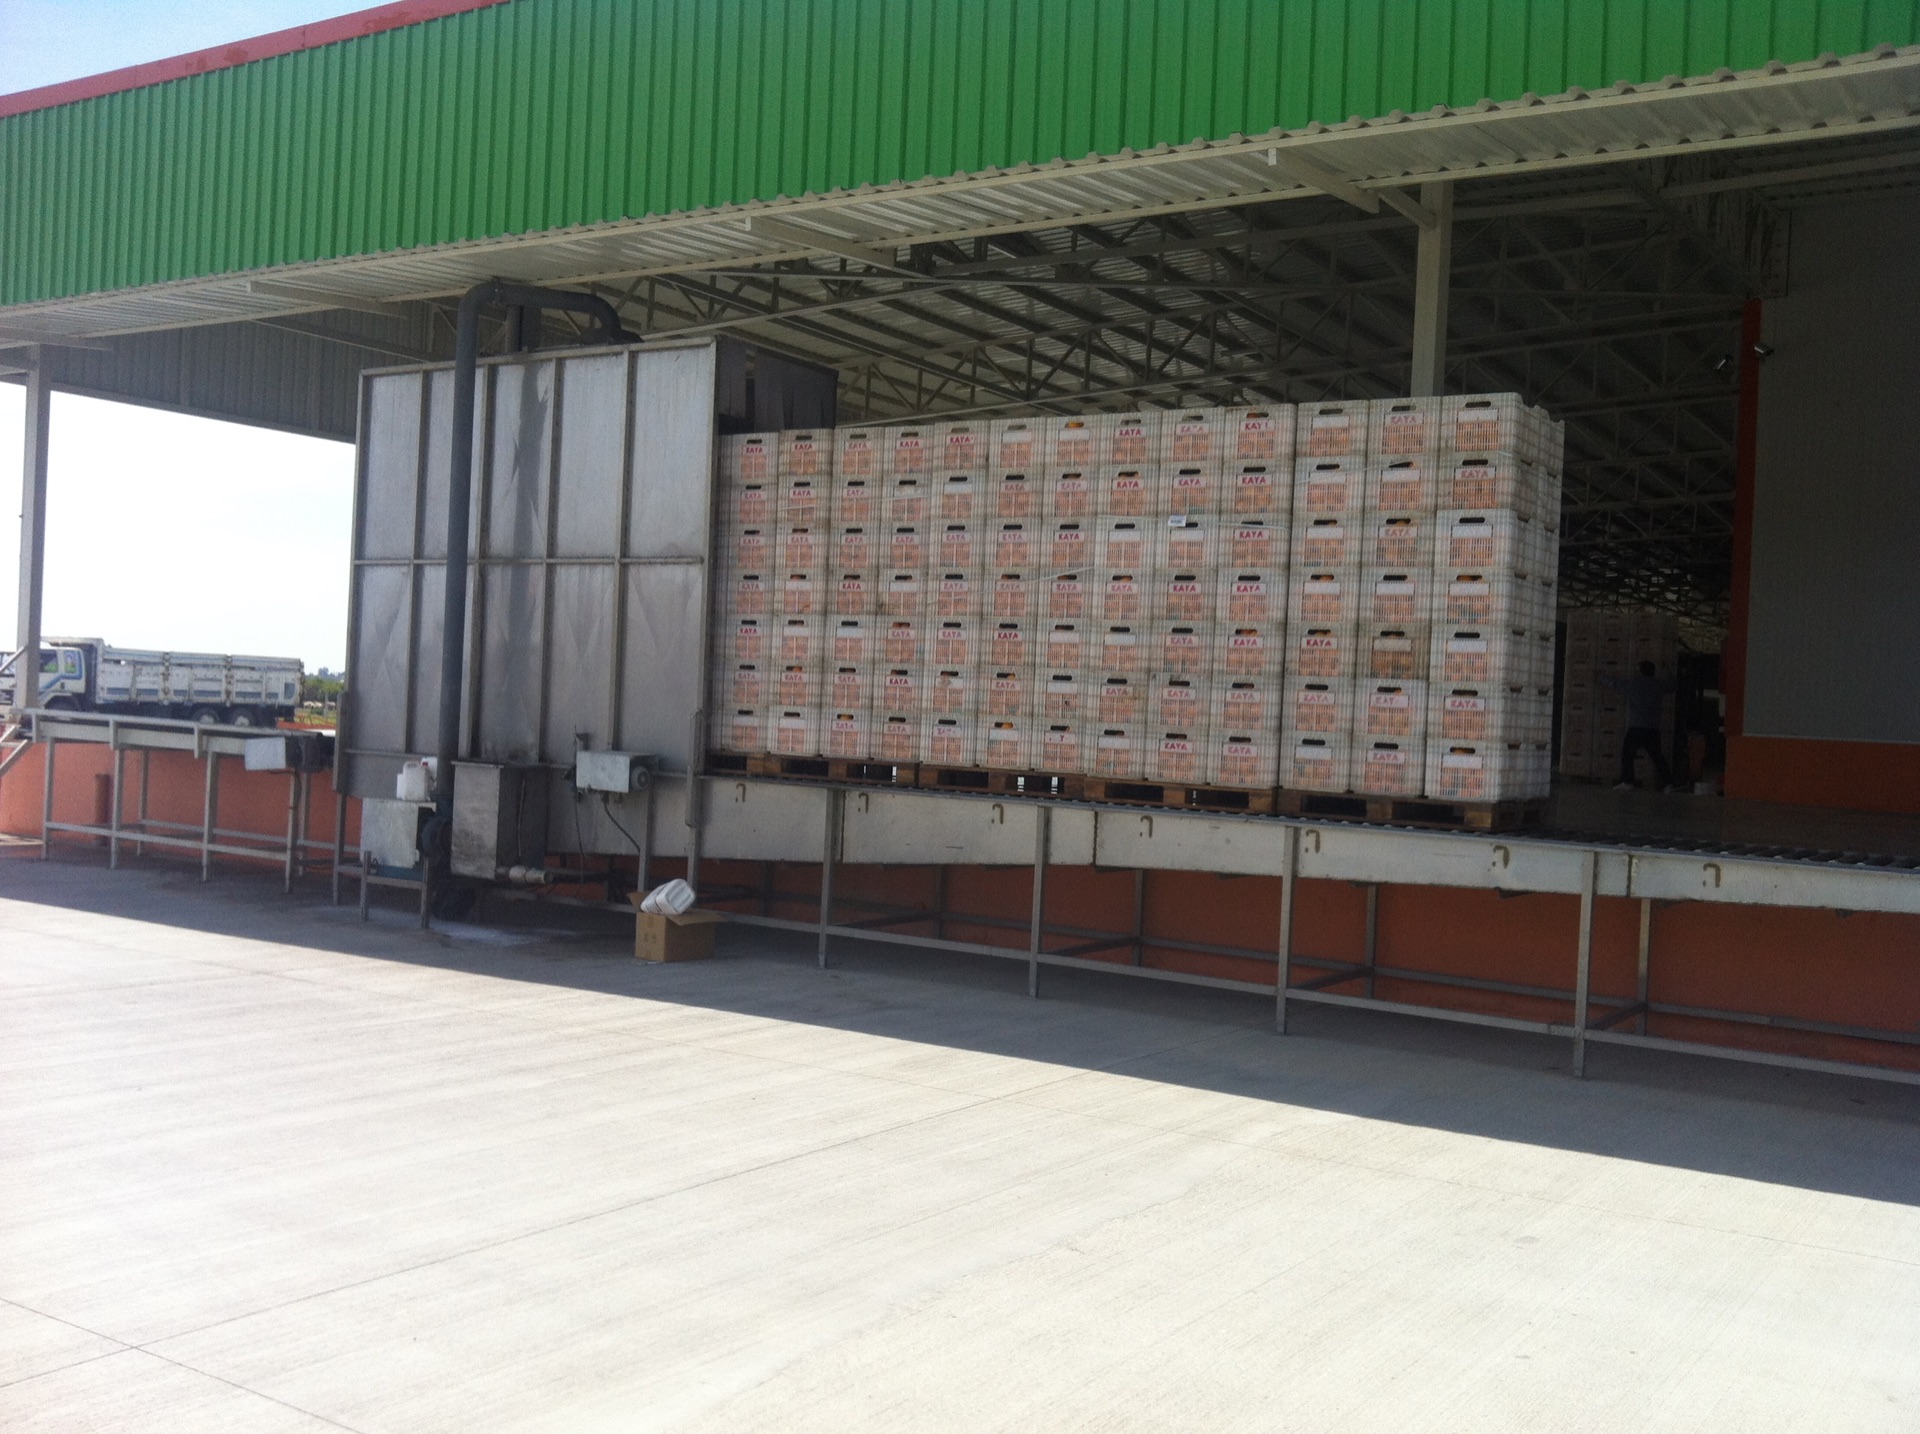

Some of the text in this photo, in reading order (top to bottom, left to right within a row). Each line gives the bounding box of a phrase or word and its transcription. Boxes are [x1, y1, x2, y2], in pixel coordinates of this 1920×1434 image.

[1119, 428, 1142, 436] KAYA
[900, 440, 919, 448] KAYA
[950, 436, 970, 444] KAYA
[848, 441, 867, 450] KAYA
[745, 446, 763, 454] KAYA
[1461, 469, 1488, 479] KAYA
[1116, 480, 1139, 488] KAYA
[1178, 478, 1201, 487] KAYA
[1241, 476, 1266, 484] KAYA
[1058, 533, 1080, 541] KAYA
[1239, 530, 1263, 539] KAYA
[790, 536, 809, 544] KAYA
[895, 536, 914, 544] KAYA
[741, 582, 760, 590] KAYA
[842, 582, 861, 590] KAYA
[1056, 583, 1078, 591] KAYA
[1173, 584, 1196, 593] KAYA
[1236, 584, 1261, 593] KAYA
[739, 627, 757, 635] KAYA
[997, 632, 1019, 640] KAYA
[1233, 638, 1258, 646] KAYA
[1306, 639, 1332, 647] KAYA
[889, 677, 909, 685] KAYA
[995, 682, 1016, 690] KAYA
[1105, 687, 1128, 696] KAYA
[1451, 699, 1478, 708] KAYA
[1164, 742, 1188, 750] KAYA
[1227, 746, 1252, 755] KAYA
